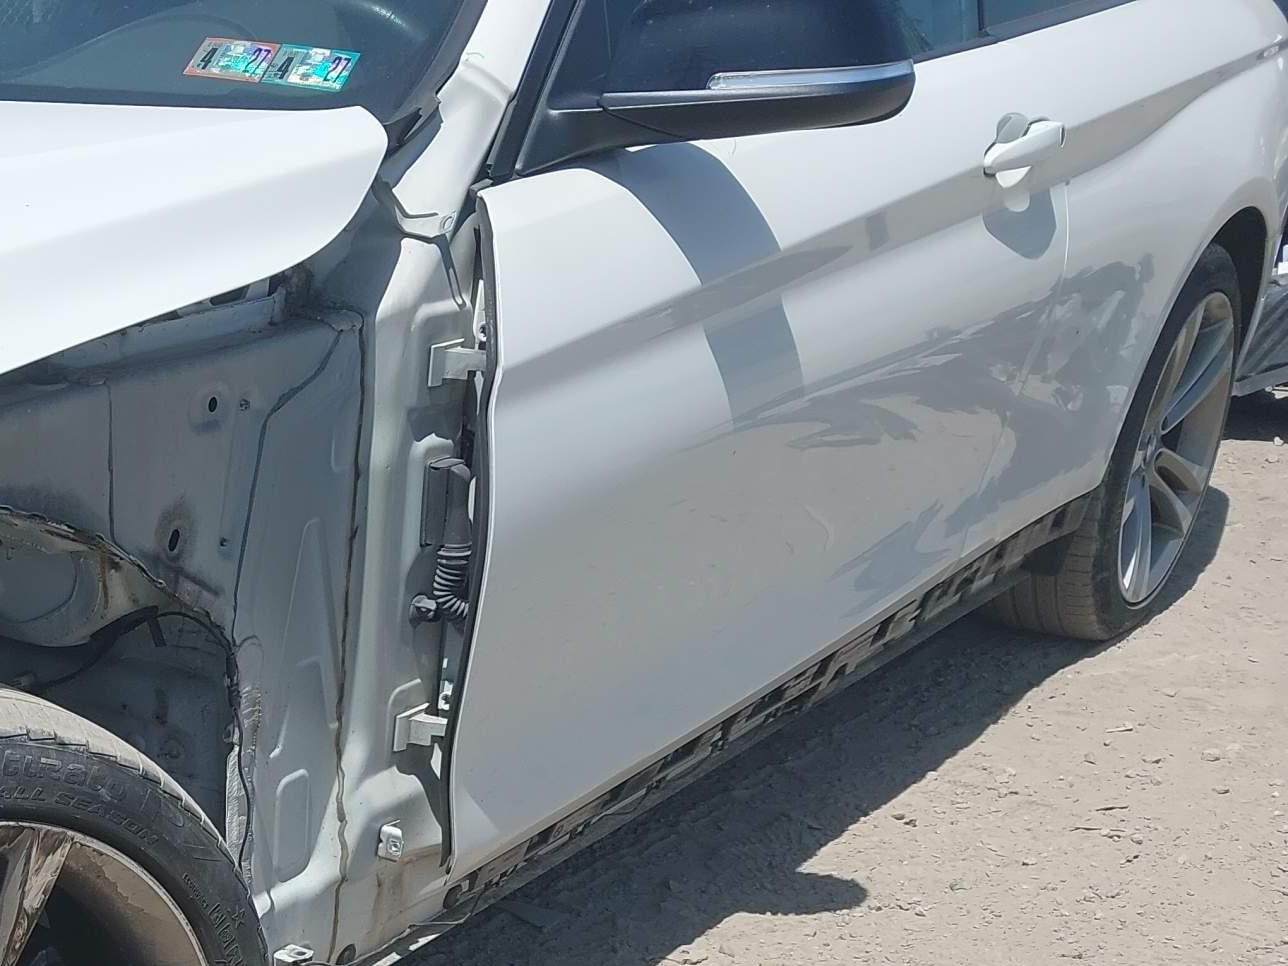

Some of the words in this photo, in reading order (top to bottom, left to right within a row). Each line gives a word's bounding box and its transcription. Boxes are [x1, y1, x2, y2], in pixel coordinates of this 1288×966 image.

[200, 47, 218, 70] 4
[242, 47, 272, 75] 27
[277, 56, 295, 80] 4
[323, 56, 352, 83] 27
[54, 792, 160, 845] SEASON
